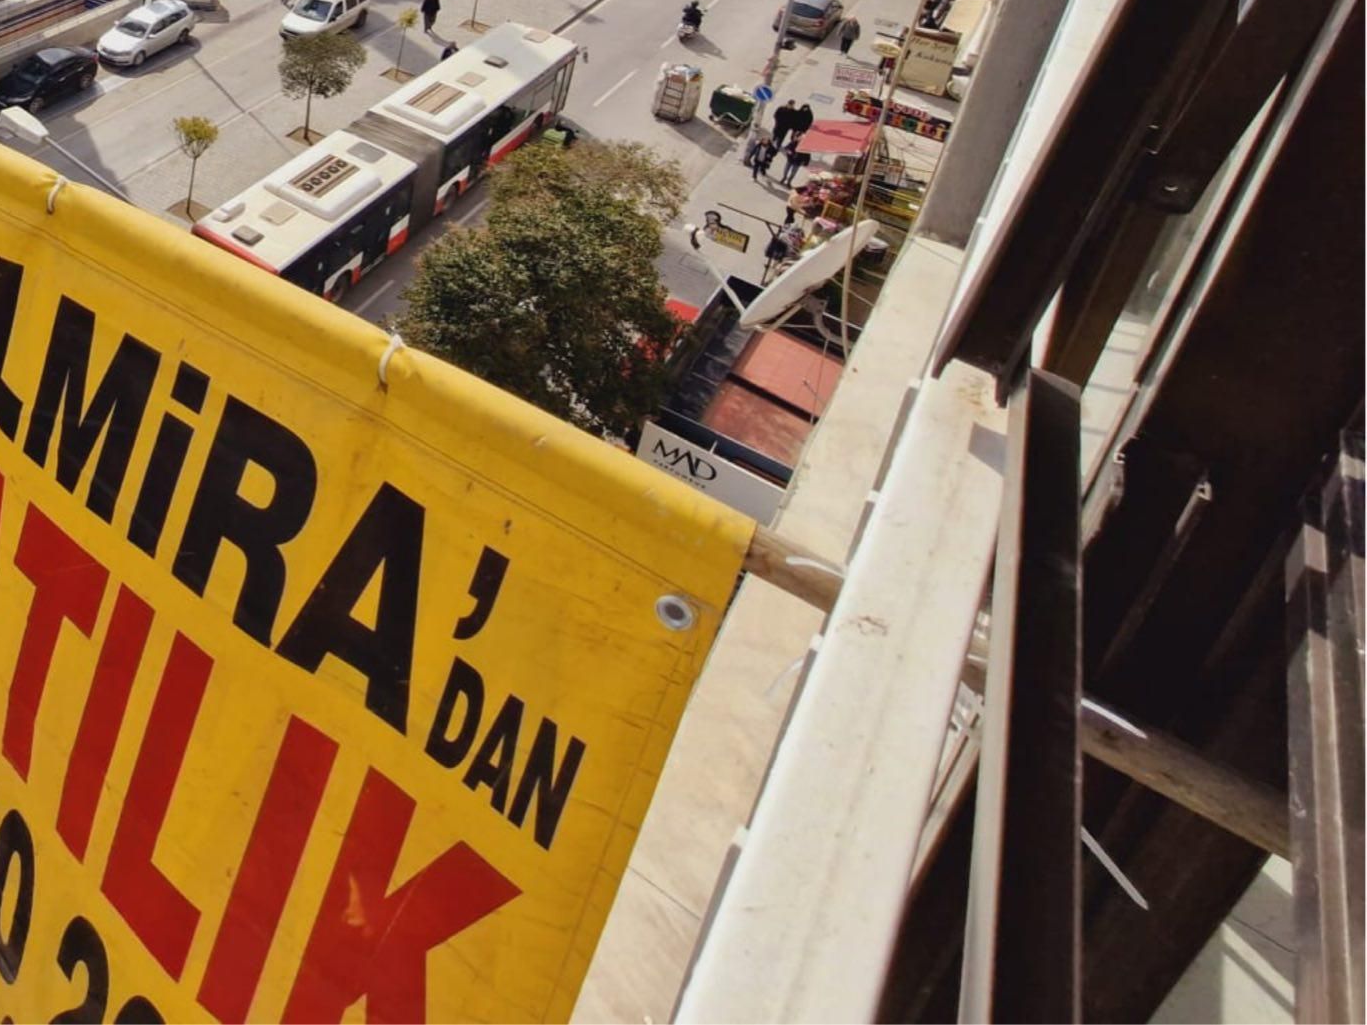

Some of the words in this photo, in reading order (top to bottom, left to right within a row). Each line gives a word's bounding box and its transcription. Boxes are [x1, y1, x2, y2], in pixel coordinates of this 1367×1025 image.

[652, 439, 717, 481] MAD
[424, 656, 587, 852] DAN
[46, 915, 168, 1025] 2
